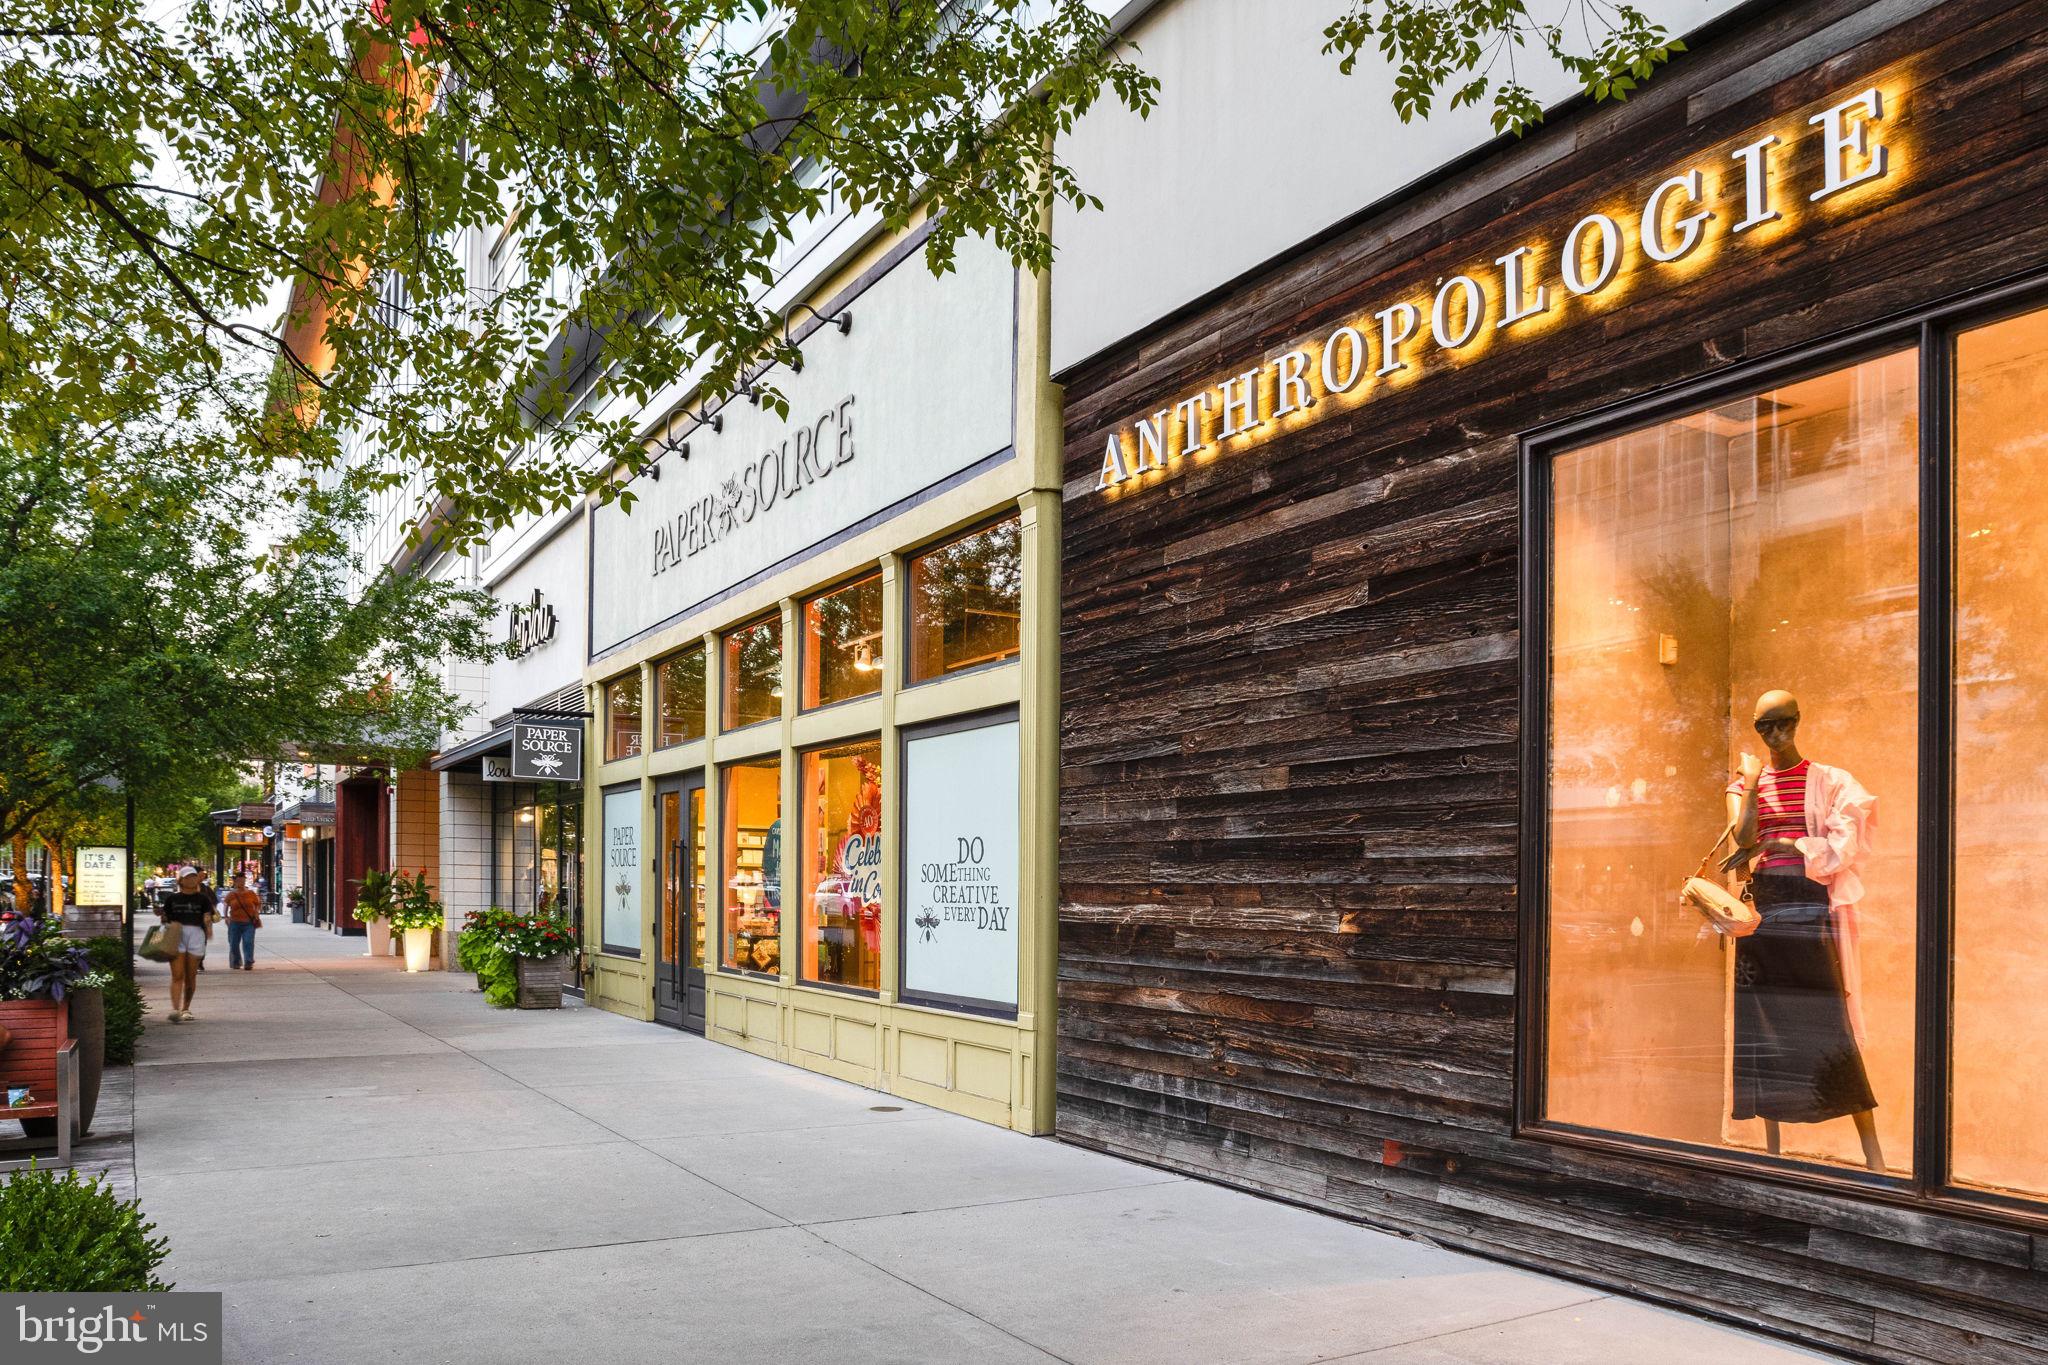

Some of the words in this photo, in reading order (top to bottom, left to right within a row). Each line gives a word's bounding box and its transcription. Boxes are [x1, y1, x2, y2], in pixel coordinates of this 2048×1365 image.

[1094, 87, 1888, 491] ANTHROPOLOGIE
[652, 493, 716, 577] PAPER
[743, 393, 855, 523] SOURCE
[527, 728, 568, 741] PAPER
[522, 740, 573, 753] SOURCE
[613, 826, 635, 846] PAPER
[84, 853, 104, 861] IT'S
[611, 848, 637, 867] SOURCE
[957, 836, 984, 864] DO
[851, 870, 863, 893] in
[921, 863, 991, 882] SOMETHING
[933, 885, 999, 904] CREATIVE
